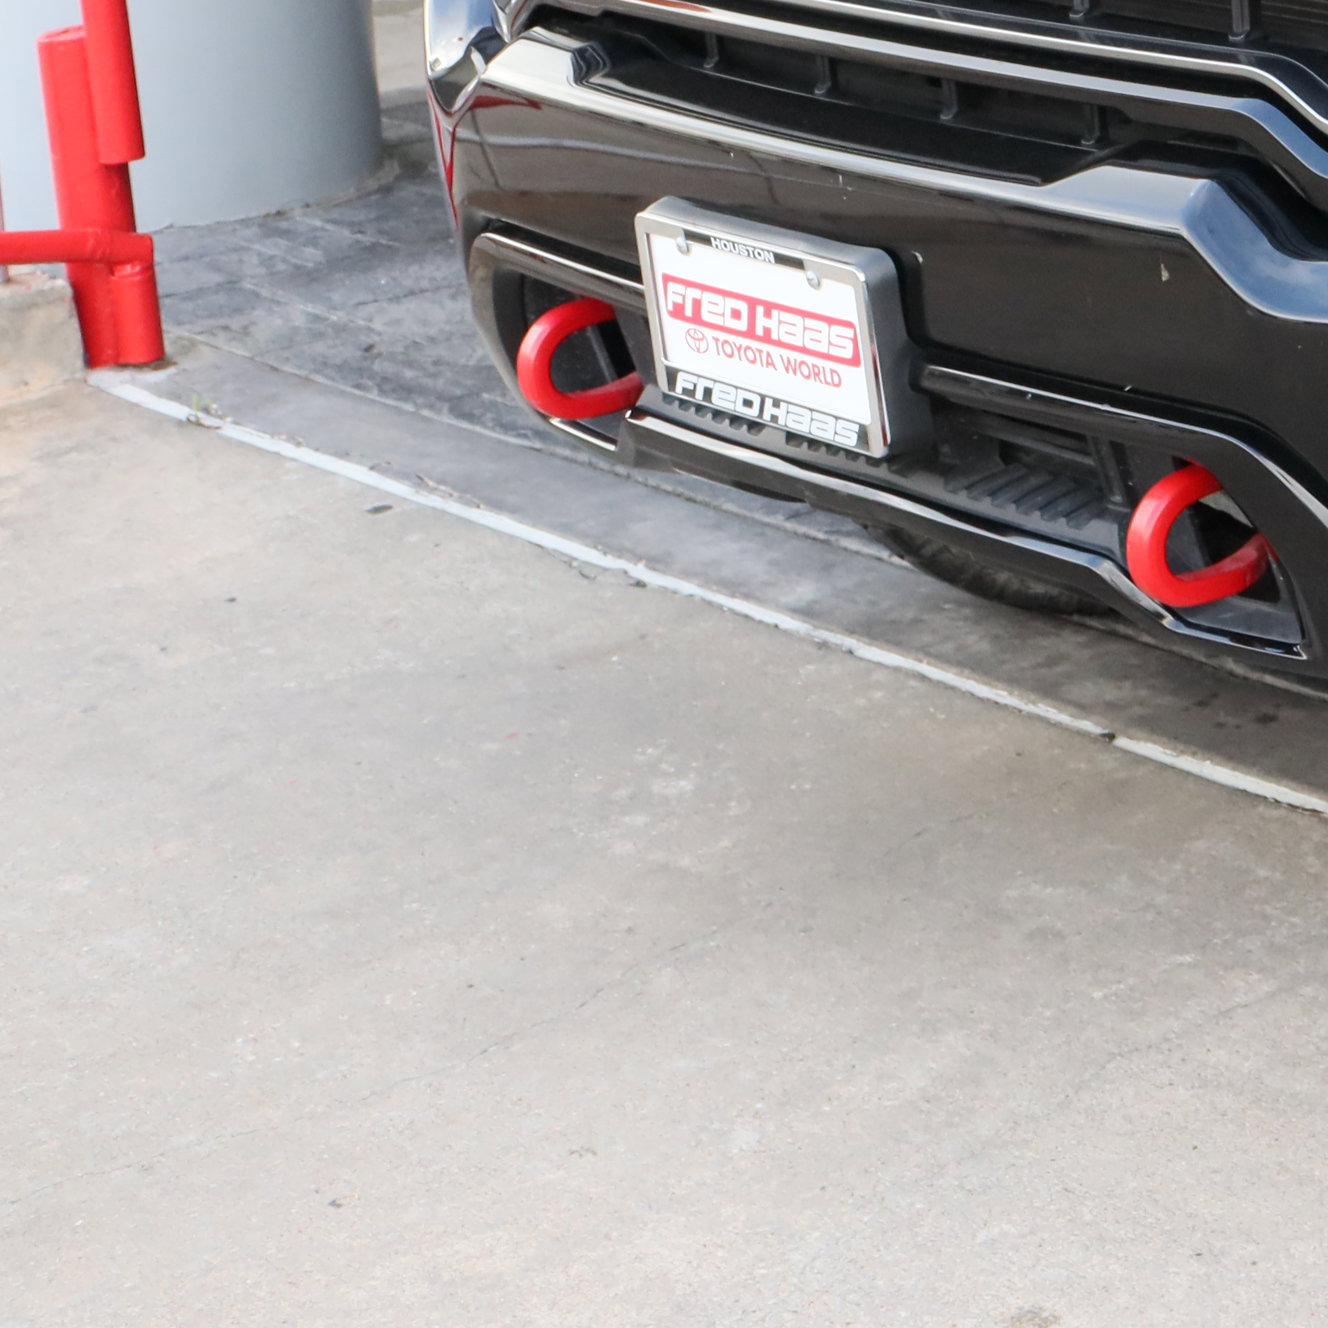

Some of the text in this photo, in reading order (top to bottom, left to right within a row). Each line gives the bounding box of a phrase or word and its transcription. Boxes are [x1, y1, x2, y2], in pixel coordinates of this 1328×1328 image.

[710, 236, 775, 264] HOUSTON
[712, 336, 842, 388] TOYOTA WORLD
